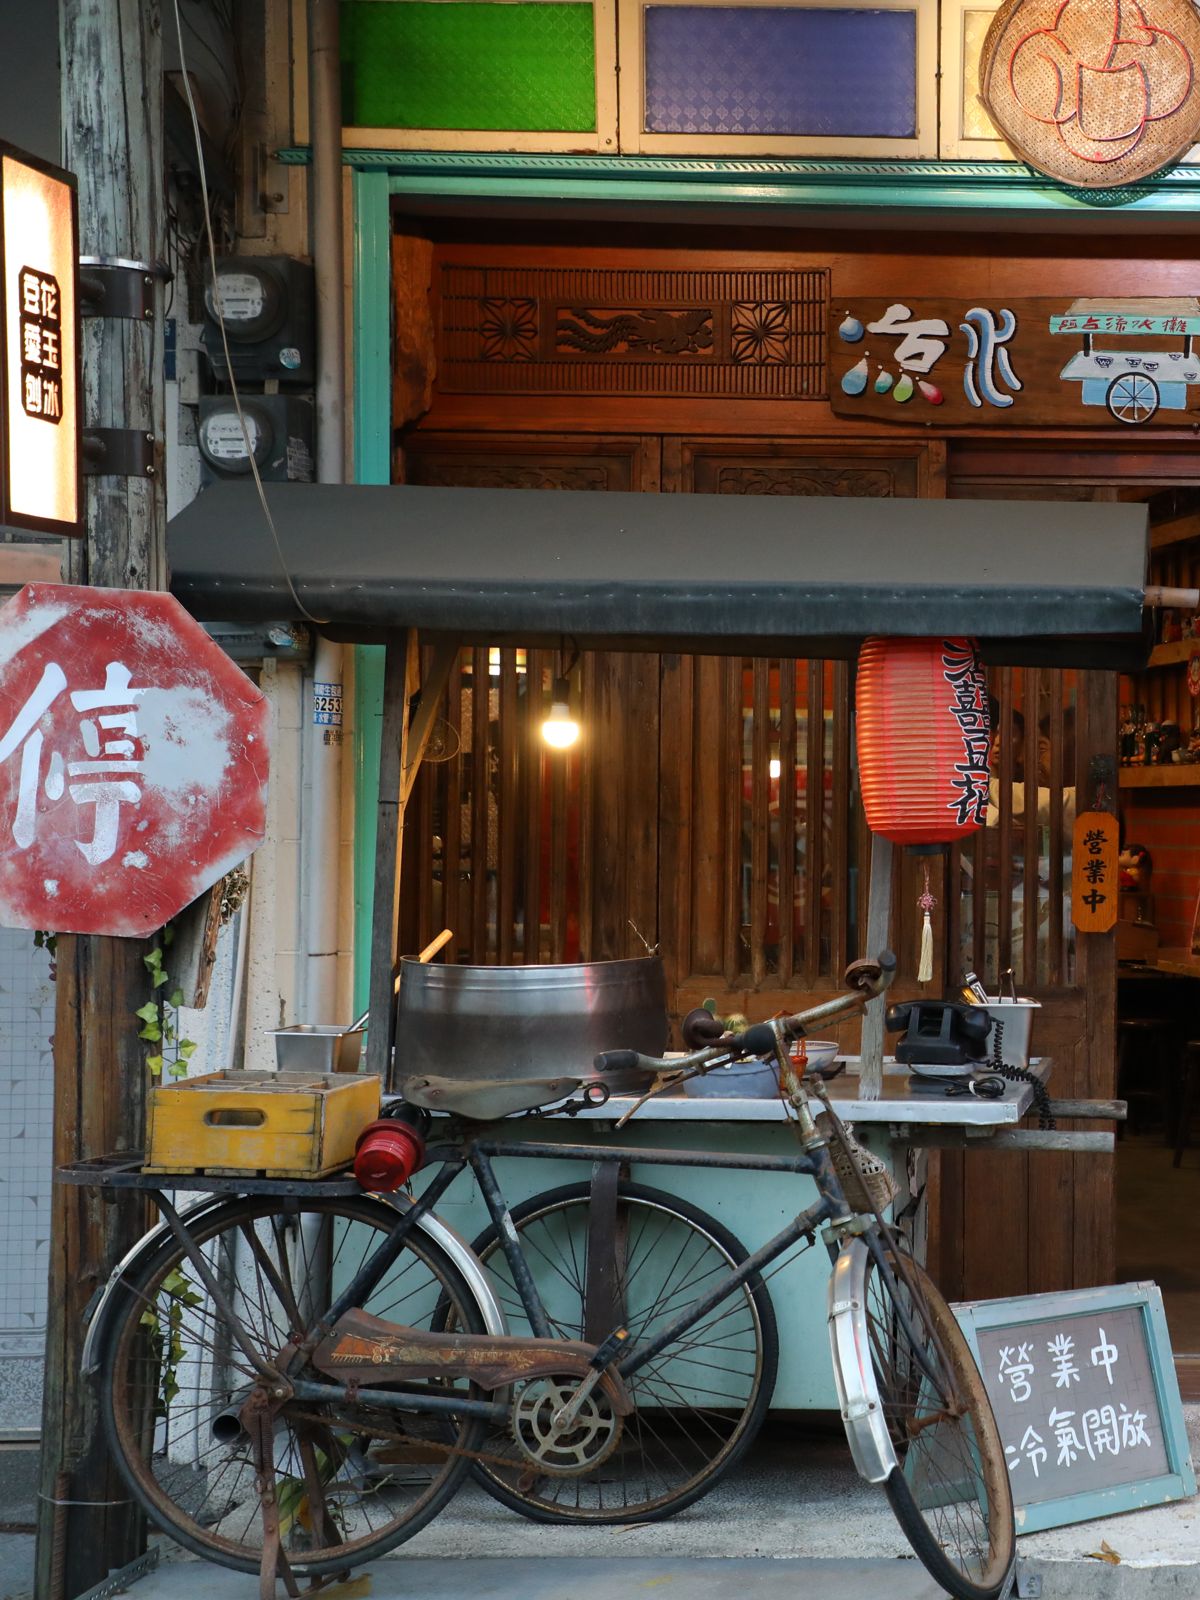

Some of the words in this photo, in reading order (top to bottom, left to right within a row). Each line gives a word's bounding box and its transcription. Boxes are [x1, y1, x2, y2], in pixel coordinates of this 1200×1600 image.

[23, 272, 58, 320] 豆花
[0, 661, 152, 866] 停
[1082, 829, 1109, 914] 營業中
[998, 1328, 1119, 1402] 營業中
[1005, 1403, 1151, 1477] 冷氣開放
